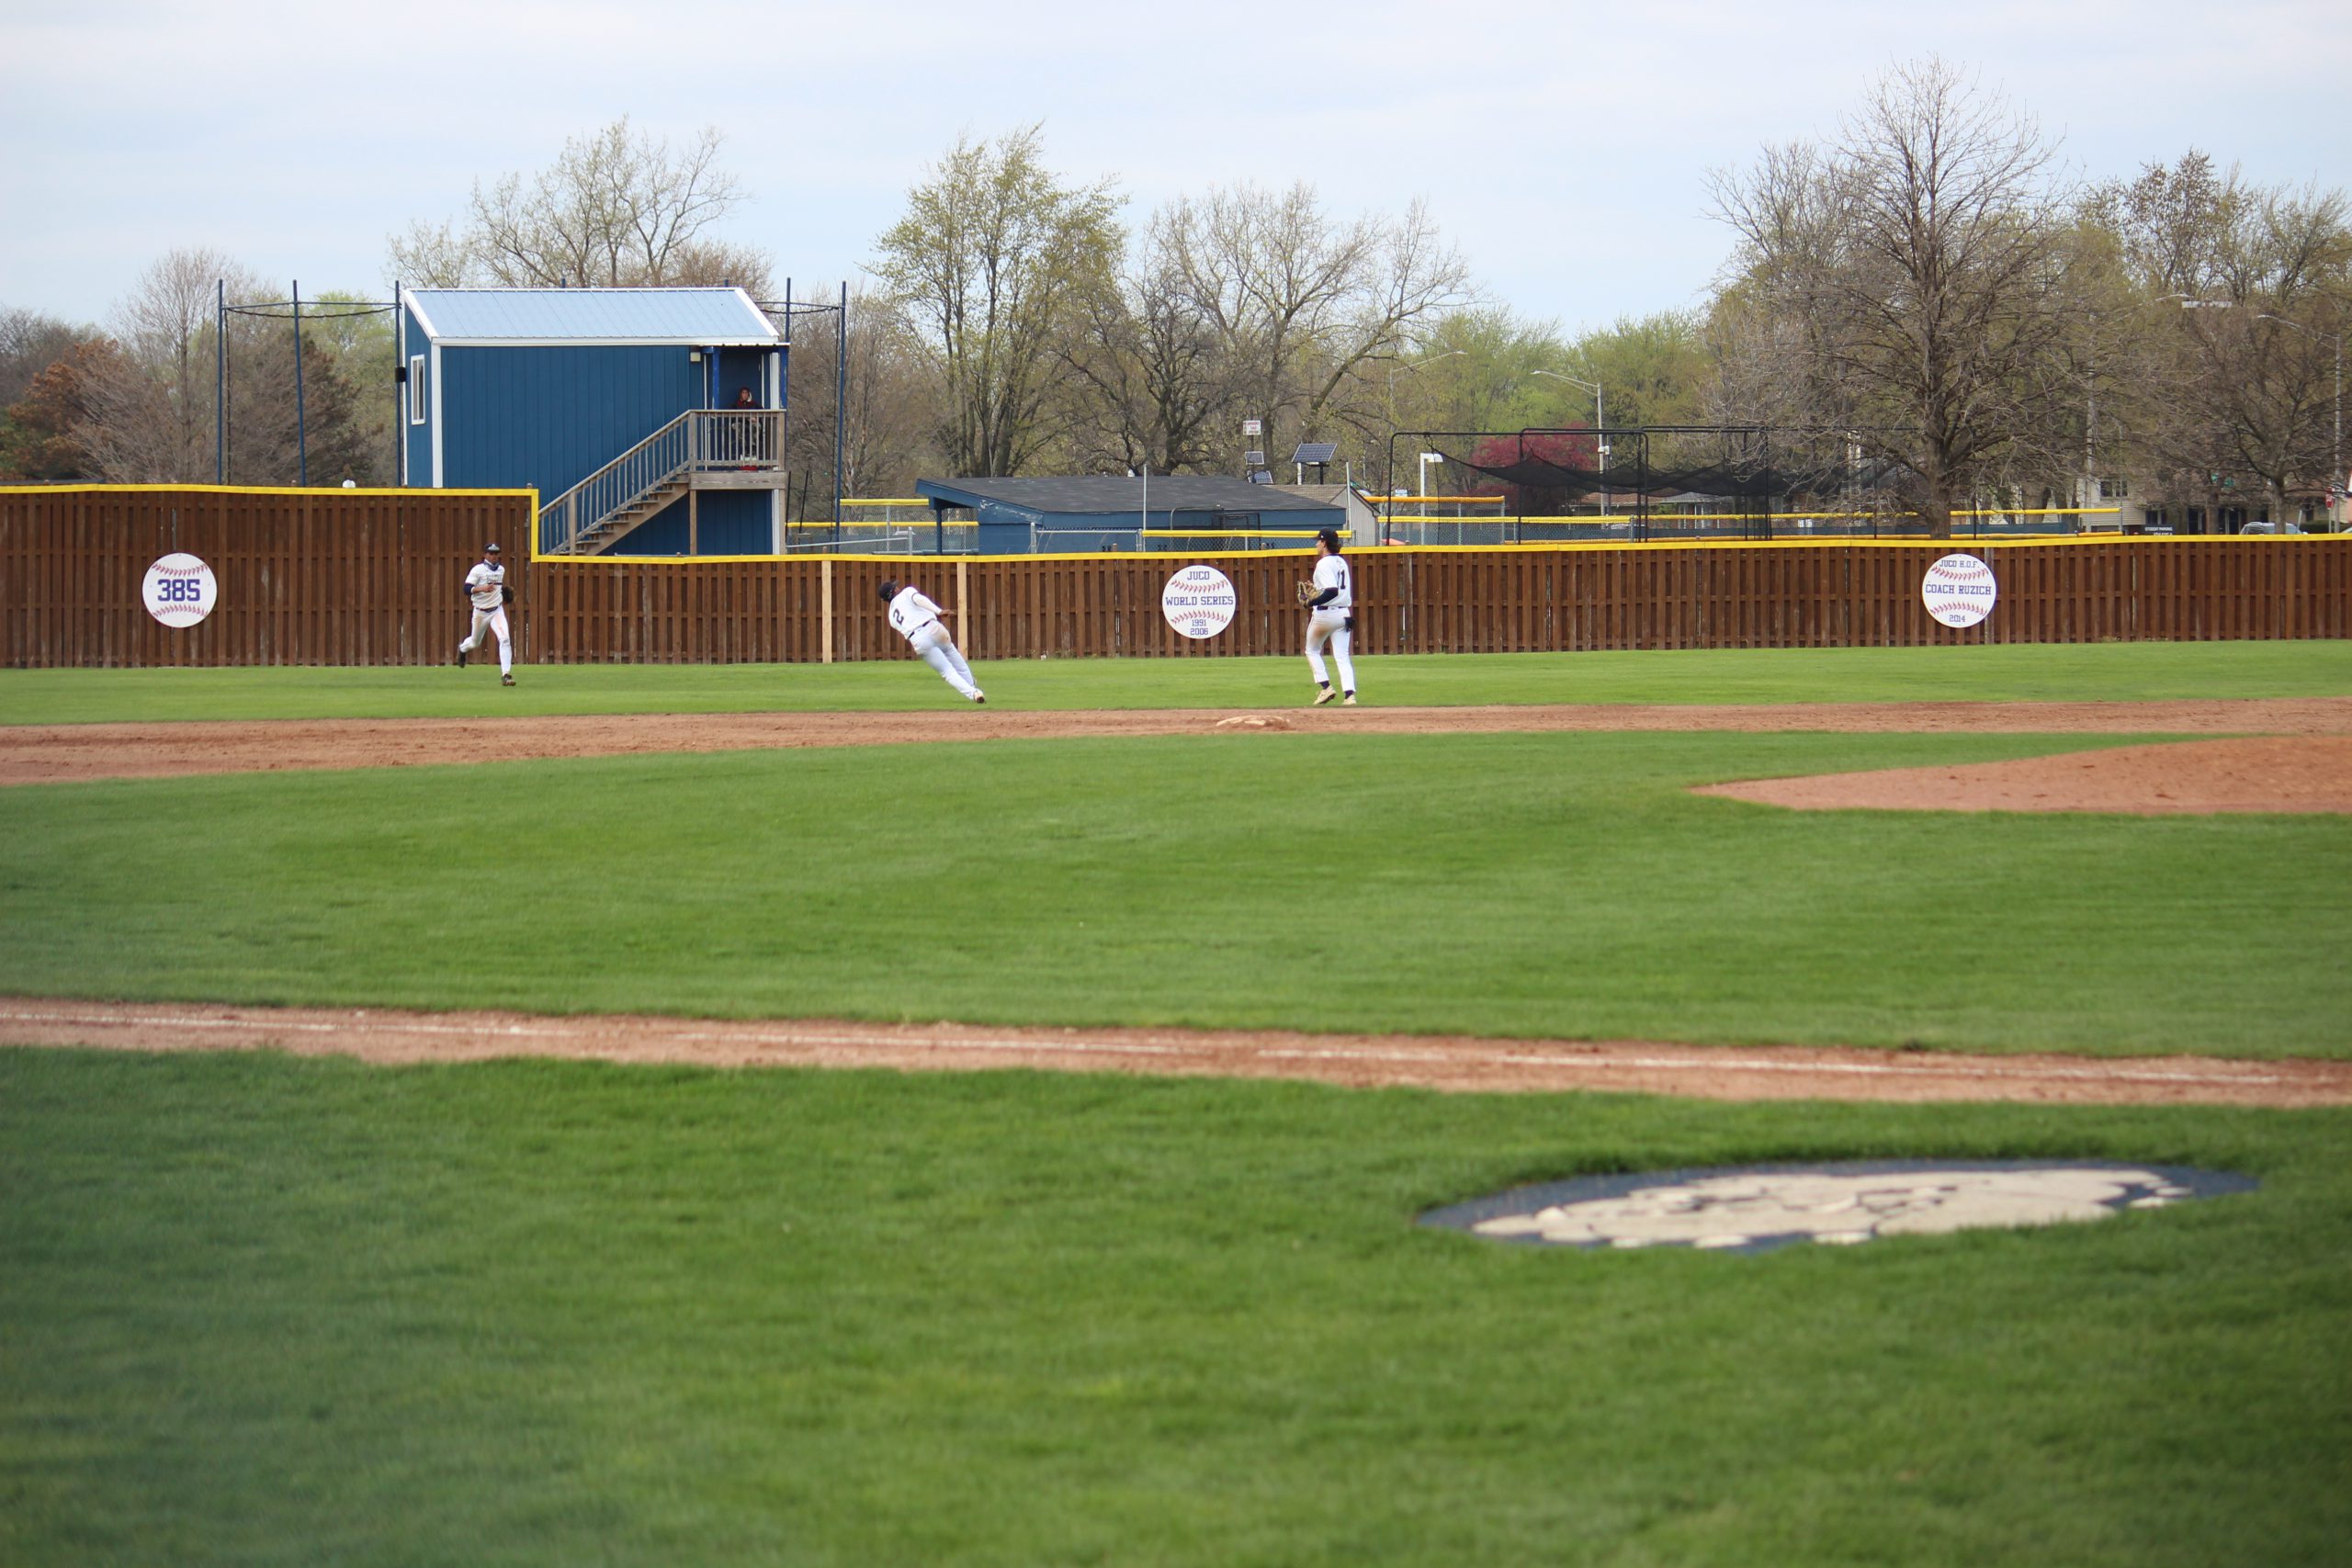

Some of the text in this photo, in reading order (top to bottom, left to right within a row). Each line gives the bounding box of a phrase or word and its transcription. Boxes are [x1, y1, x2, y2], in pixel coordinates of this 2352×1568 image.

[1939, 559, 1957, 568] JUCO
[1187, 570, 1210, 581] JUCO
[157, 579, 200, 602] 385
[1925, 583, 1992, 595] COACH RUZICH
[1165, 595, 1234, 606] WORLD SERIES
[893, 608, 904, 626] 2
[1192, 618, 1207, 626] 1991
[1949, 614, 1966, 623] 2014
